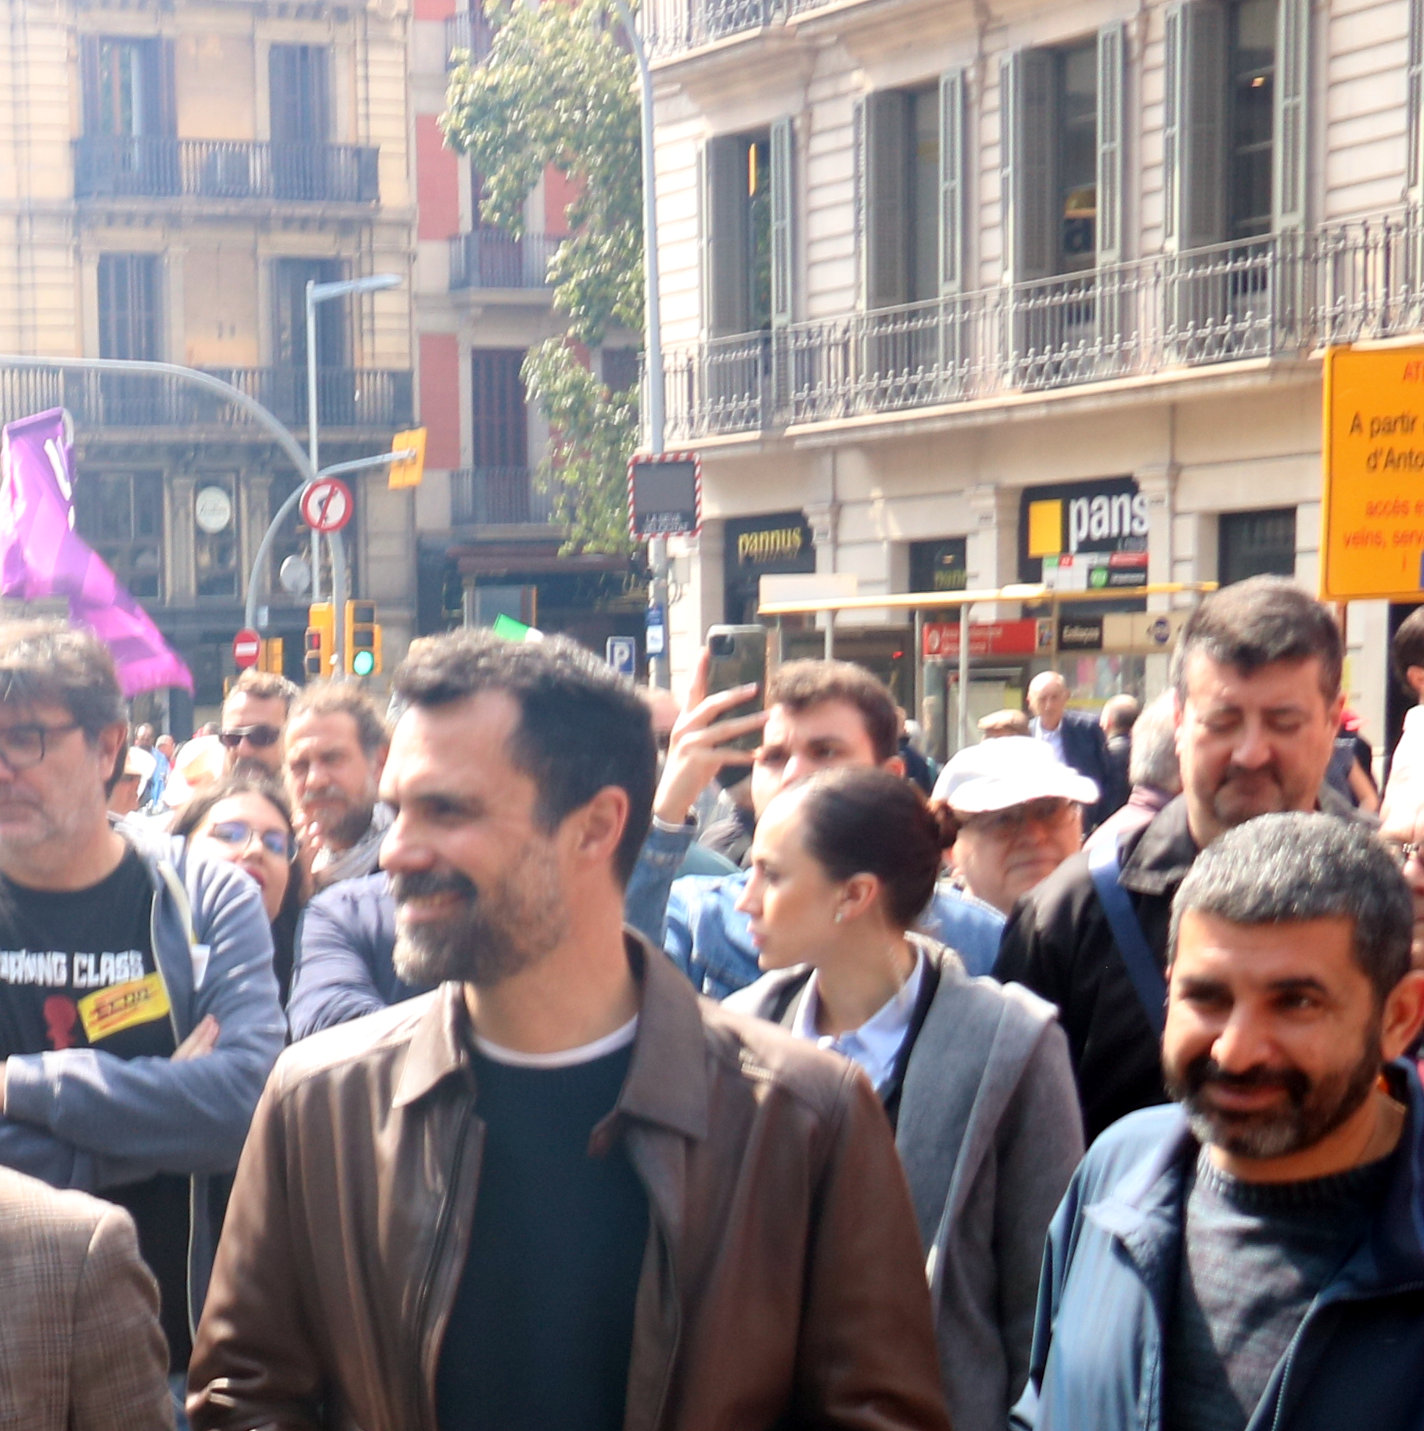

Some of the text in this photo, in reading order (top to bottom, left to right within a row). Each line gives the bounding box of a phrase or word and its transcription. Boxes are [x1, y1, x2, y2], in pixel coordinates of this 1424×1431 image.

[1350, 410, 1418, 438] A partir
[1070, 491, 1150, 554] pans
[738, 526, 802, 557] pannus
[72, 949, 145, 989] CLASS
